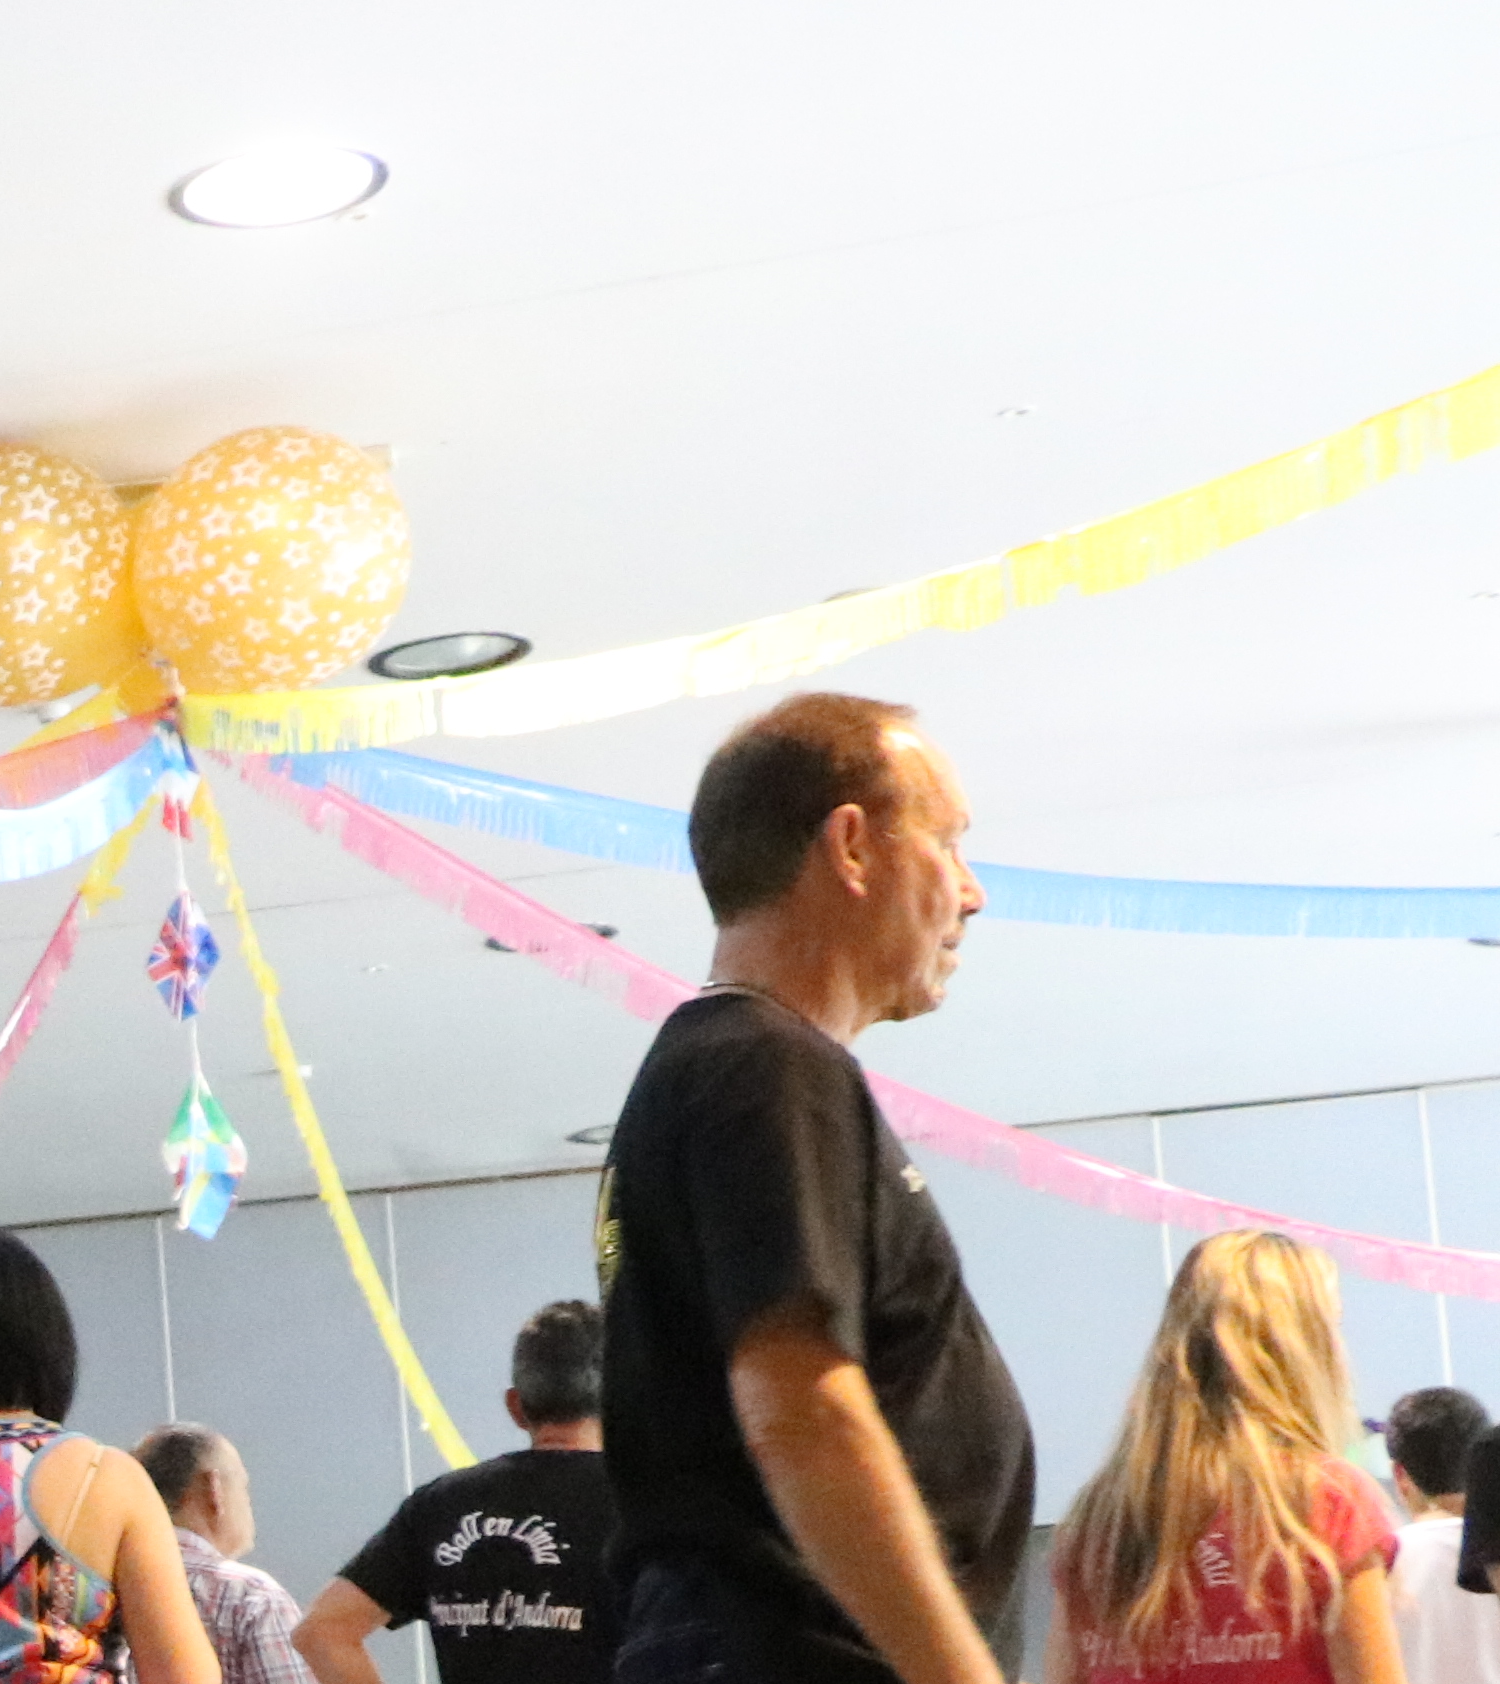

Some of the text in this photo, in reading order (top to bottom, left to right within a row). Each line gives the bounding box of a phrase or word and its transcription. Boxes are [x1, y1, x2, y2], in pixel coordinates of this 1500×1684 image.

[434, 1510, 484, 1566] Ball
[483, 1516, 515, 1537] en
[491, 1588, 584, 1631] d'Andorra
